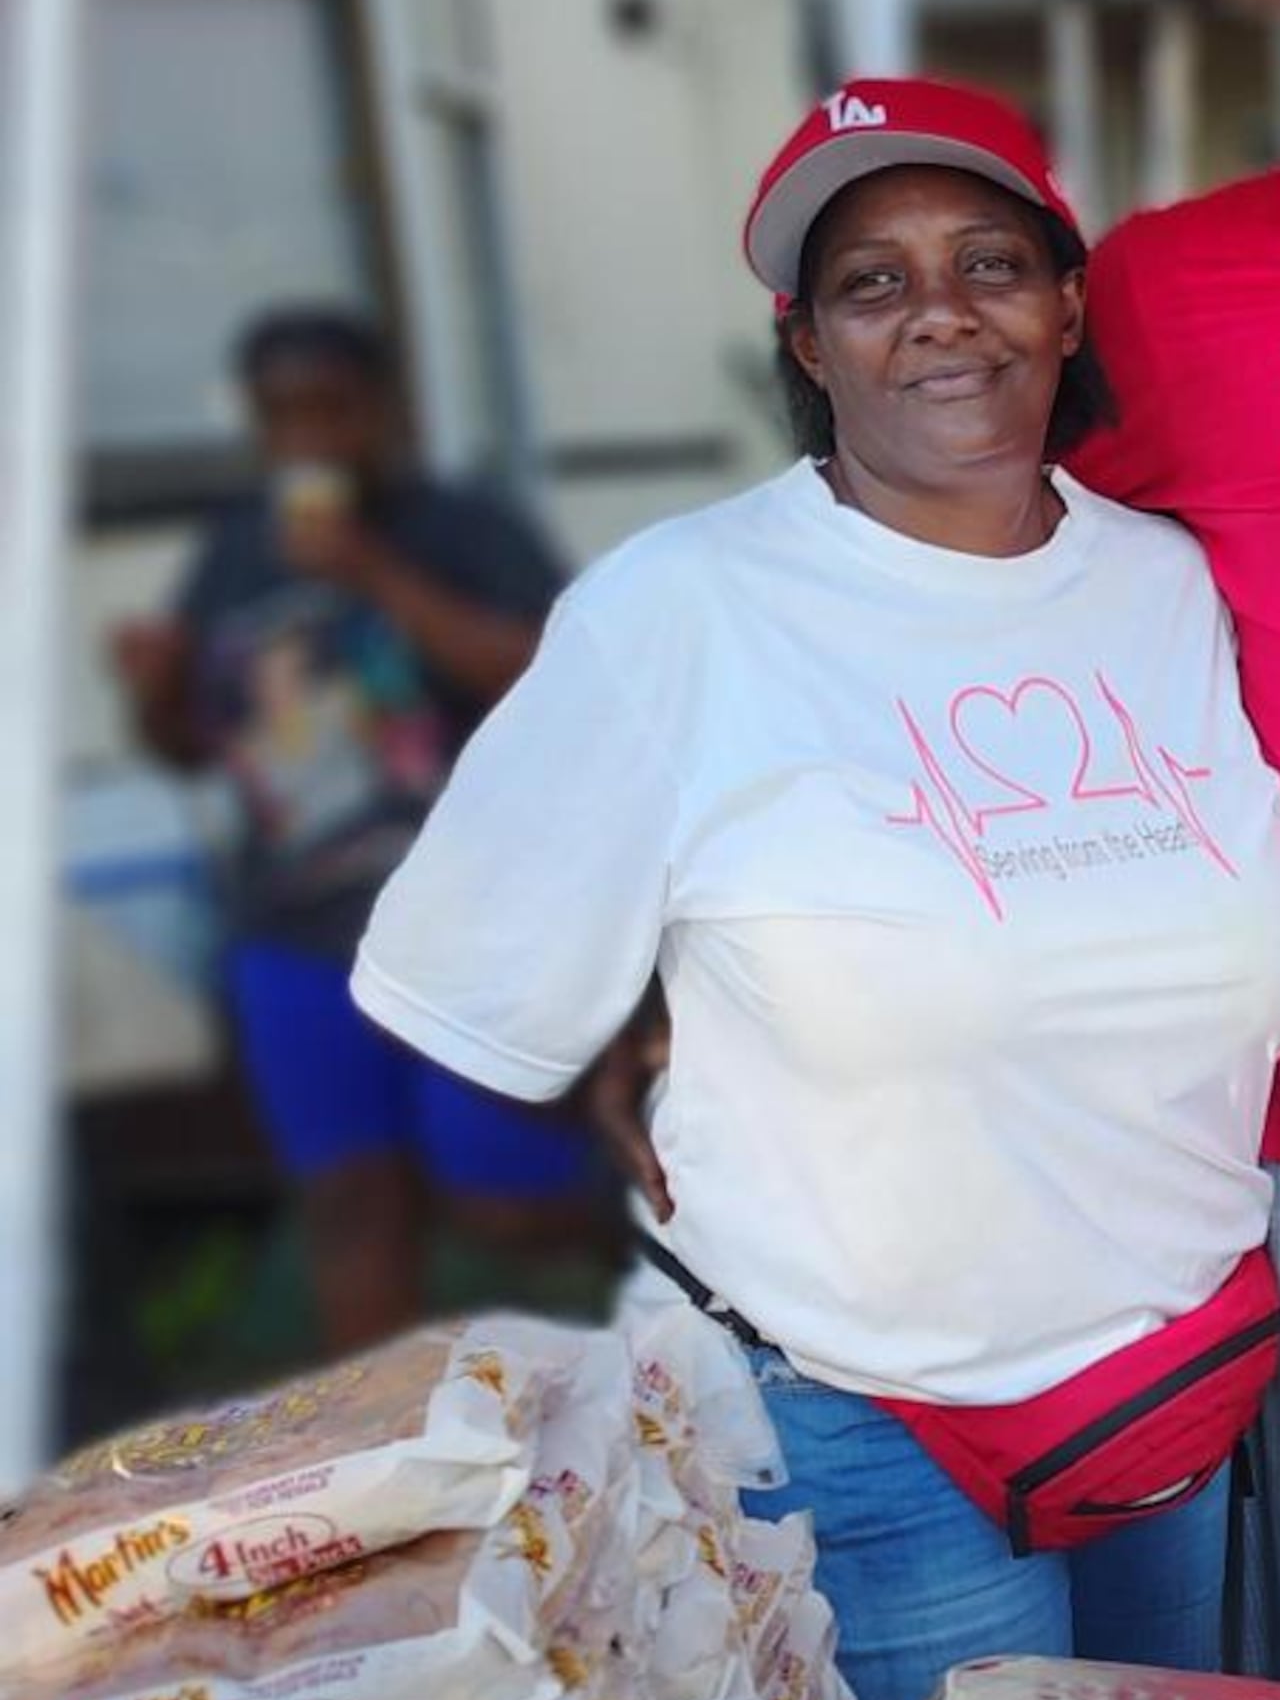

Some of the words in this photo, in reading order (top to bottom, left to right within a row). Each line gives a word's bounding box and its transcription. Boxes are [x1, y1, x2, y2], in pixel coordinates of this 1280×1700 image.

[32, 1513, 191, 1626] Martin's
[197, 1540, 231, 1579] 4
[235, 1524, 310, 1565] Inch
